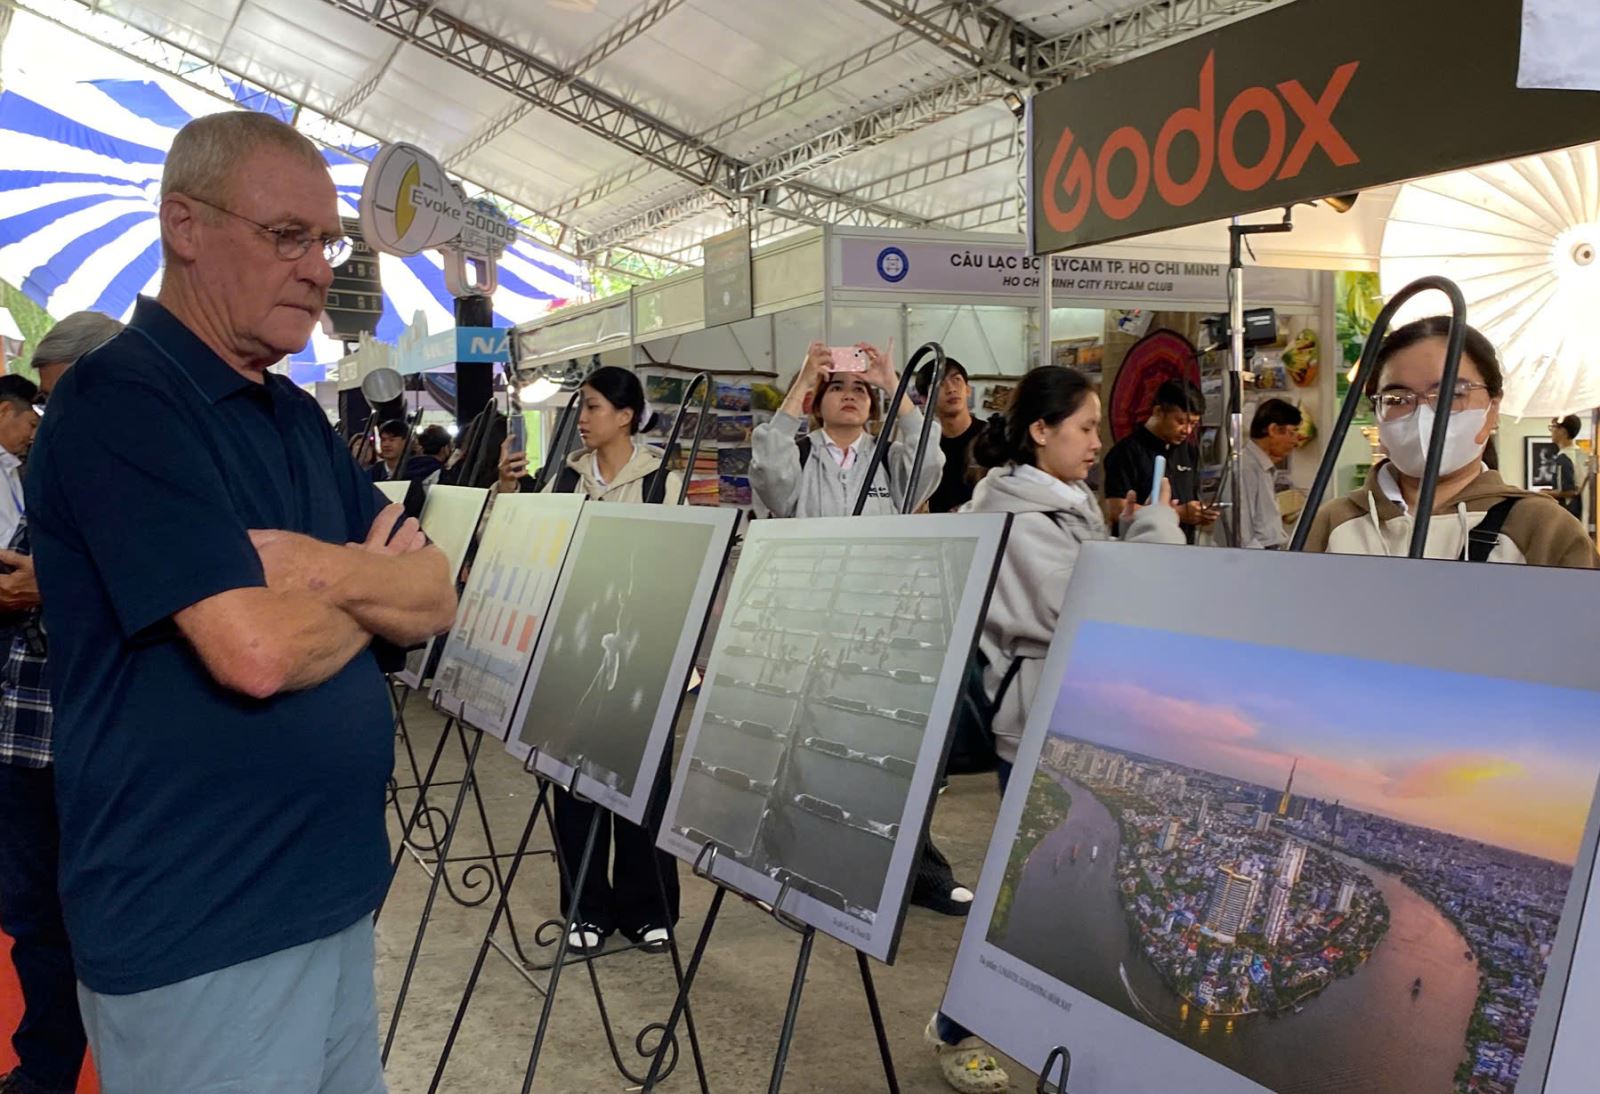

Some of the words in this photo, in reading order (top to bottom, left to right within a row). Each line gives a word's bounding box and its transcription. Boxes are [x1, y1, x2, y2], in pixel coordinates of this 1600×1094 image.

[1042, 48, 1360, 233] Godox
[411, 189, 461, 220] Evoke
[950, 250, 983, 268] CÂU
[988, 254, 1018, 272] LẠC
[1052, 259, 1102, 273] LYCAM
[1106, 260, 1125, 274] TP.
[1183, 263, 1220, 277] MINH
[1002, 276, 1021, 287] HO
[1077, 279, 1101, 290] CITY
[1103, 280, 1144, 291] FLYCAM
[1147, 281, 1173, 292] CLUB
